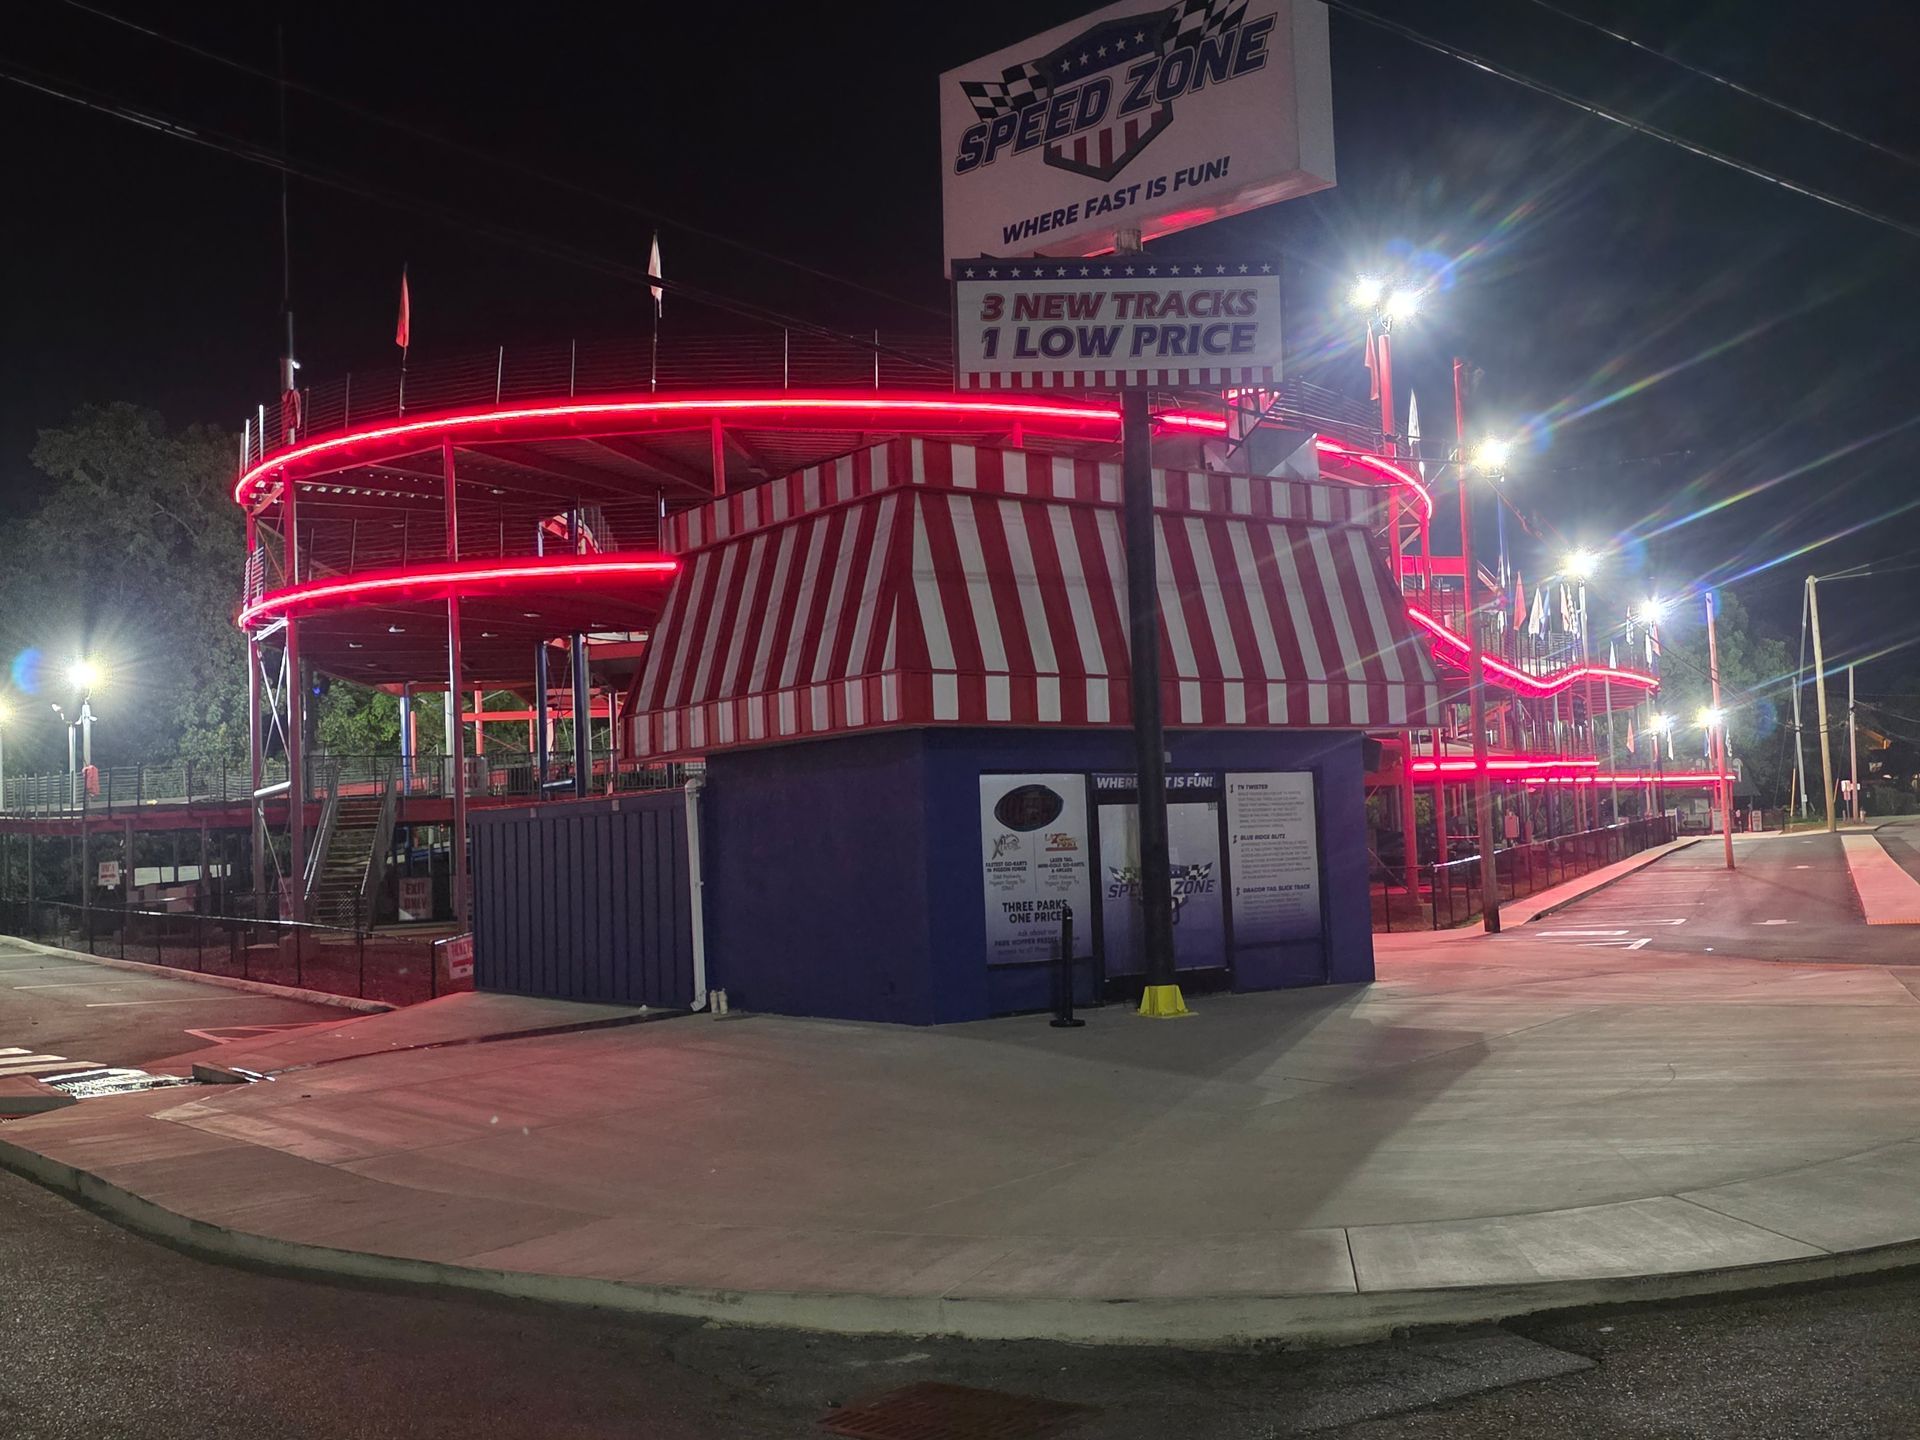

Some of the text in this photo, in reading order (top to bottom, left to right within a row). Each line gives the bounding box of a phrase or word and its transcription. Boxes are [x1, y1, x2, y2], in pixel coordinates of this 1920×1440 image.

[954, 12, 1279, 176] SPEED ZONE
[1003, 156, 1231, 245] WHERE FAST IS FUN!
[980, 289, 1258, 322] 3 NEW TRACKS
[981, 322, 1259, 360] 1 LOW PRICE
[1096, 777, 1138, 789] WHERE
[1174, 777, 1185, 788] IS
[1186, 776, 1213, 788] FUN!
[405, 882, 425, 895] EXIT
[1108, 880, 1216, 899] SPE ZONE
[403, 897, 427, 910] ONLY
[1002, 899, 1068, 913] THREE PARKS
[1009, 911, 1062, 923] ONE PRICE
